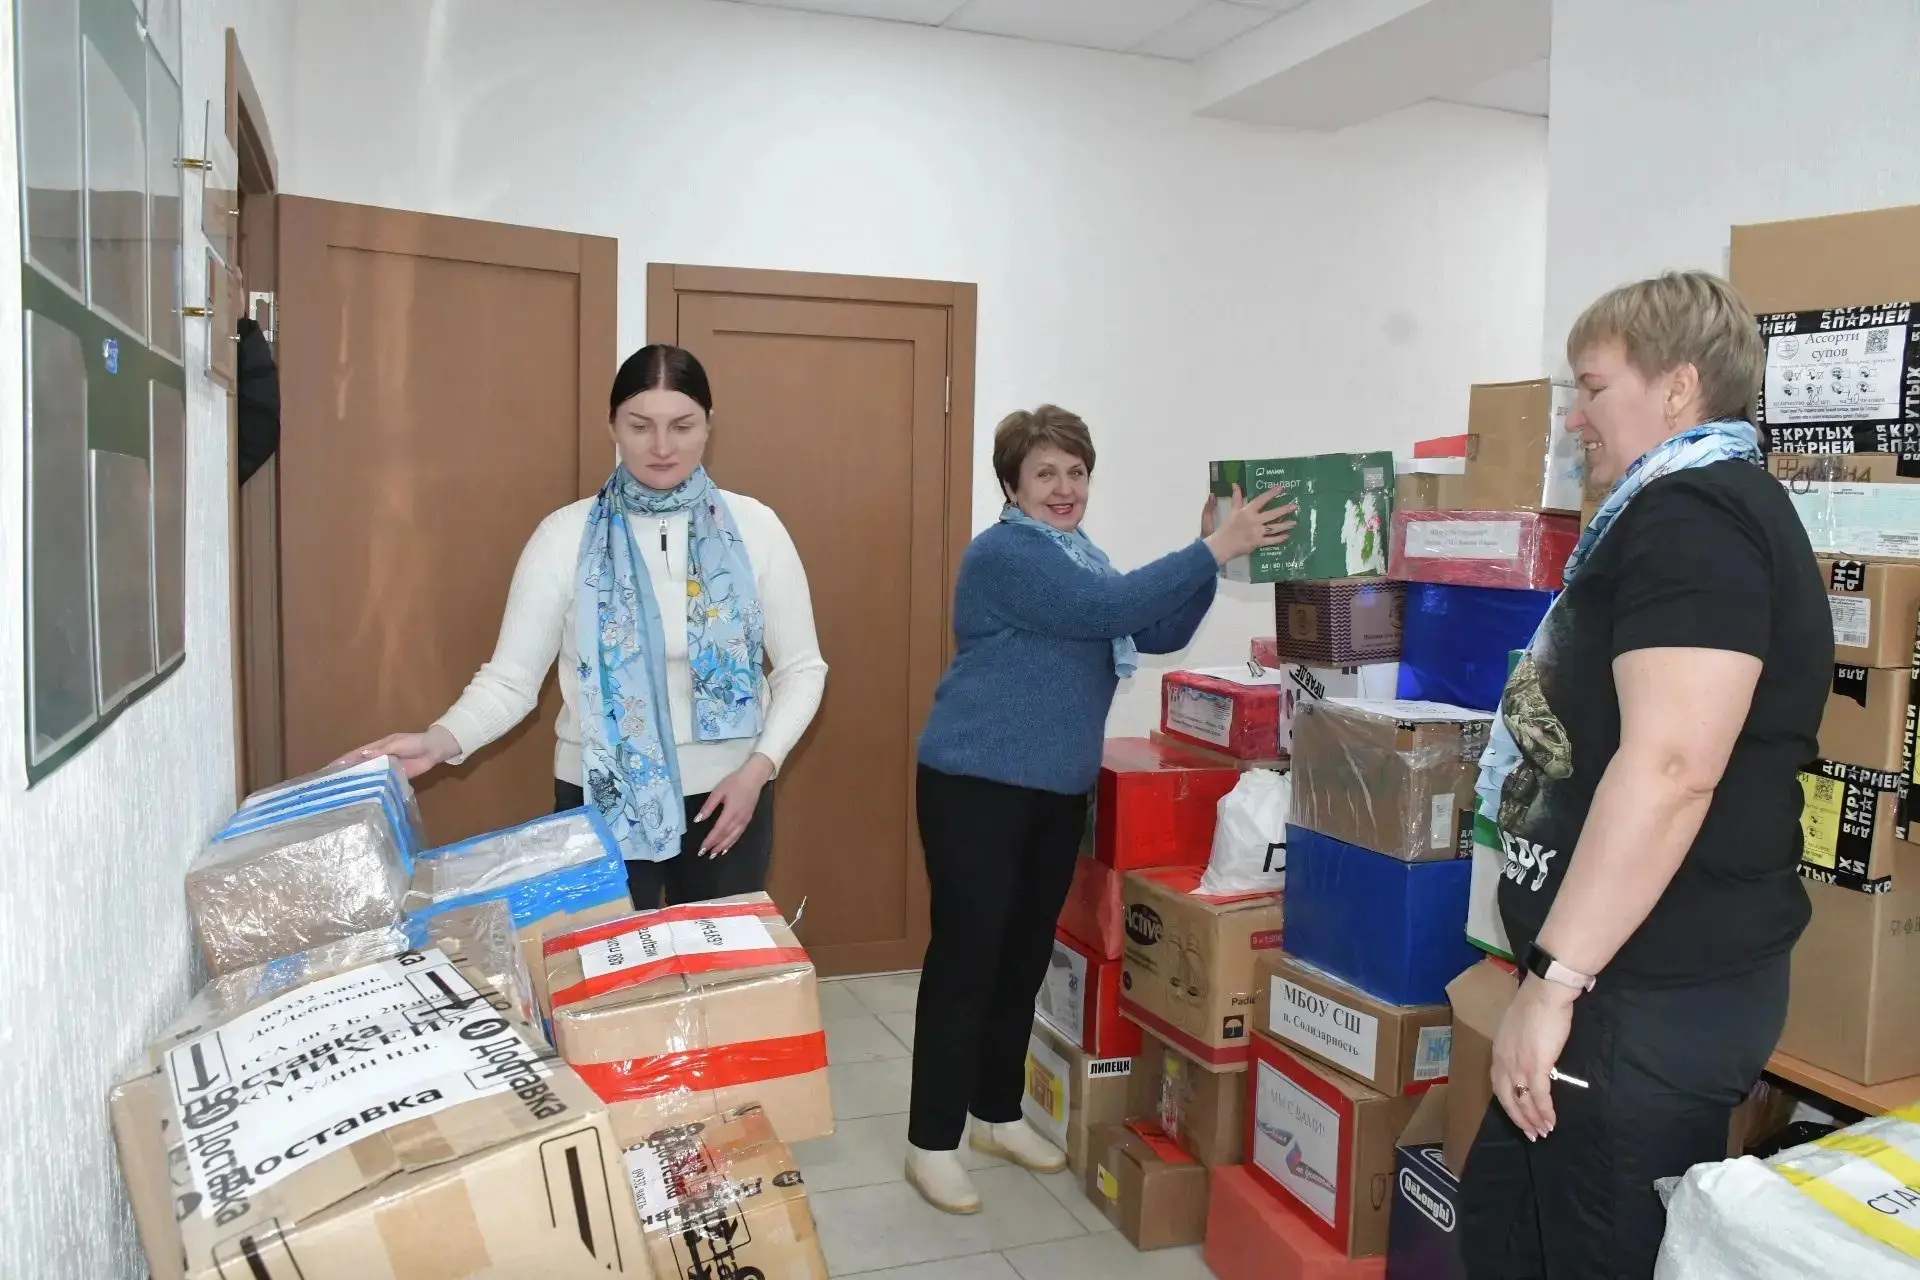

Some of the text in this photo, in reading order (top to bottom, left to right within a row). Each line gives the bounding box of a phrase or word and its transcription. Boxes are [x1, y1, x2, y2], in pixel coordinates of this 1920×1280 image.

[1805, 332, 1860, 347] Ассорти
[1811, 347, 1848, 362] супов
[1782, 426, 1854, 441] КРУТЫХ
[1256, 479, 1301, 490] Стандарт
[1283, 983, 1361, 1035] МБОУ СШ
[1292, 1015, 1359, 1057] Солидарность
[1089, 1060, 1130, 1075] ЛИПЕЦК
